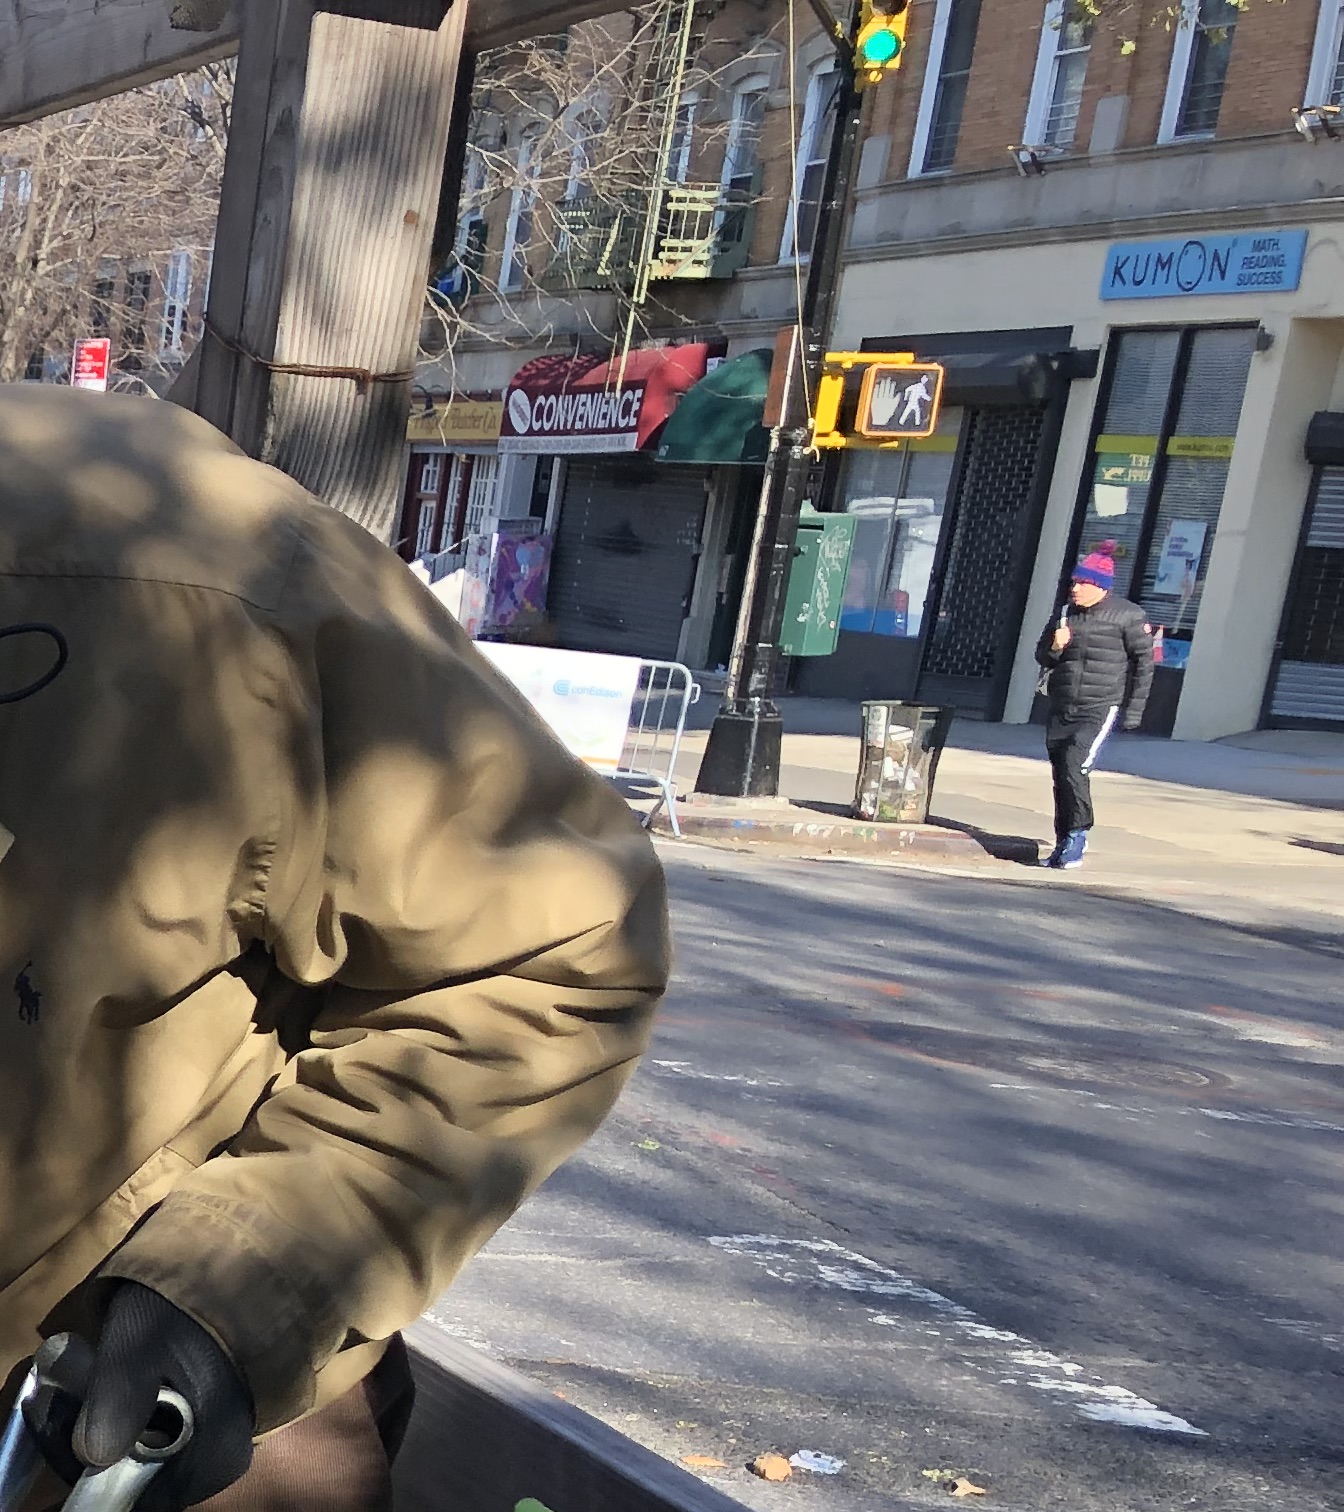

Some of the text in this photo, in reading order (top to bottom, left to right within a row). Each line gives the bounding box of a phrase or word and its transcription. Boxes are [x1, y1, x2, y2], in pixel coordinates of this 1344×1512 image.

[1110, 240, 1231, 292] KUMON
[530, 388, 644, 432] CONVENIENCE
[571, 684, 623, 700] conEdison
